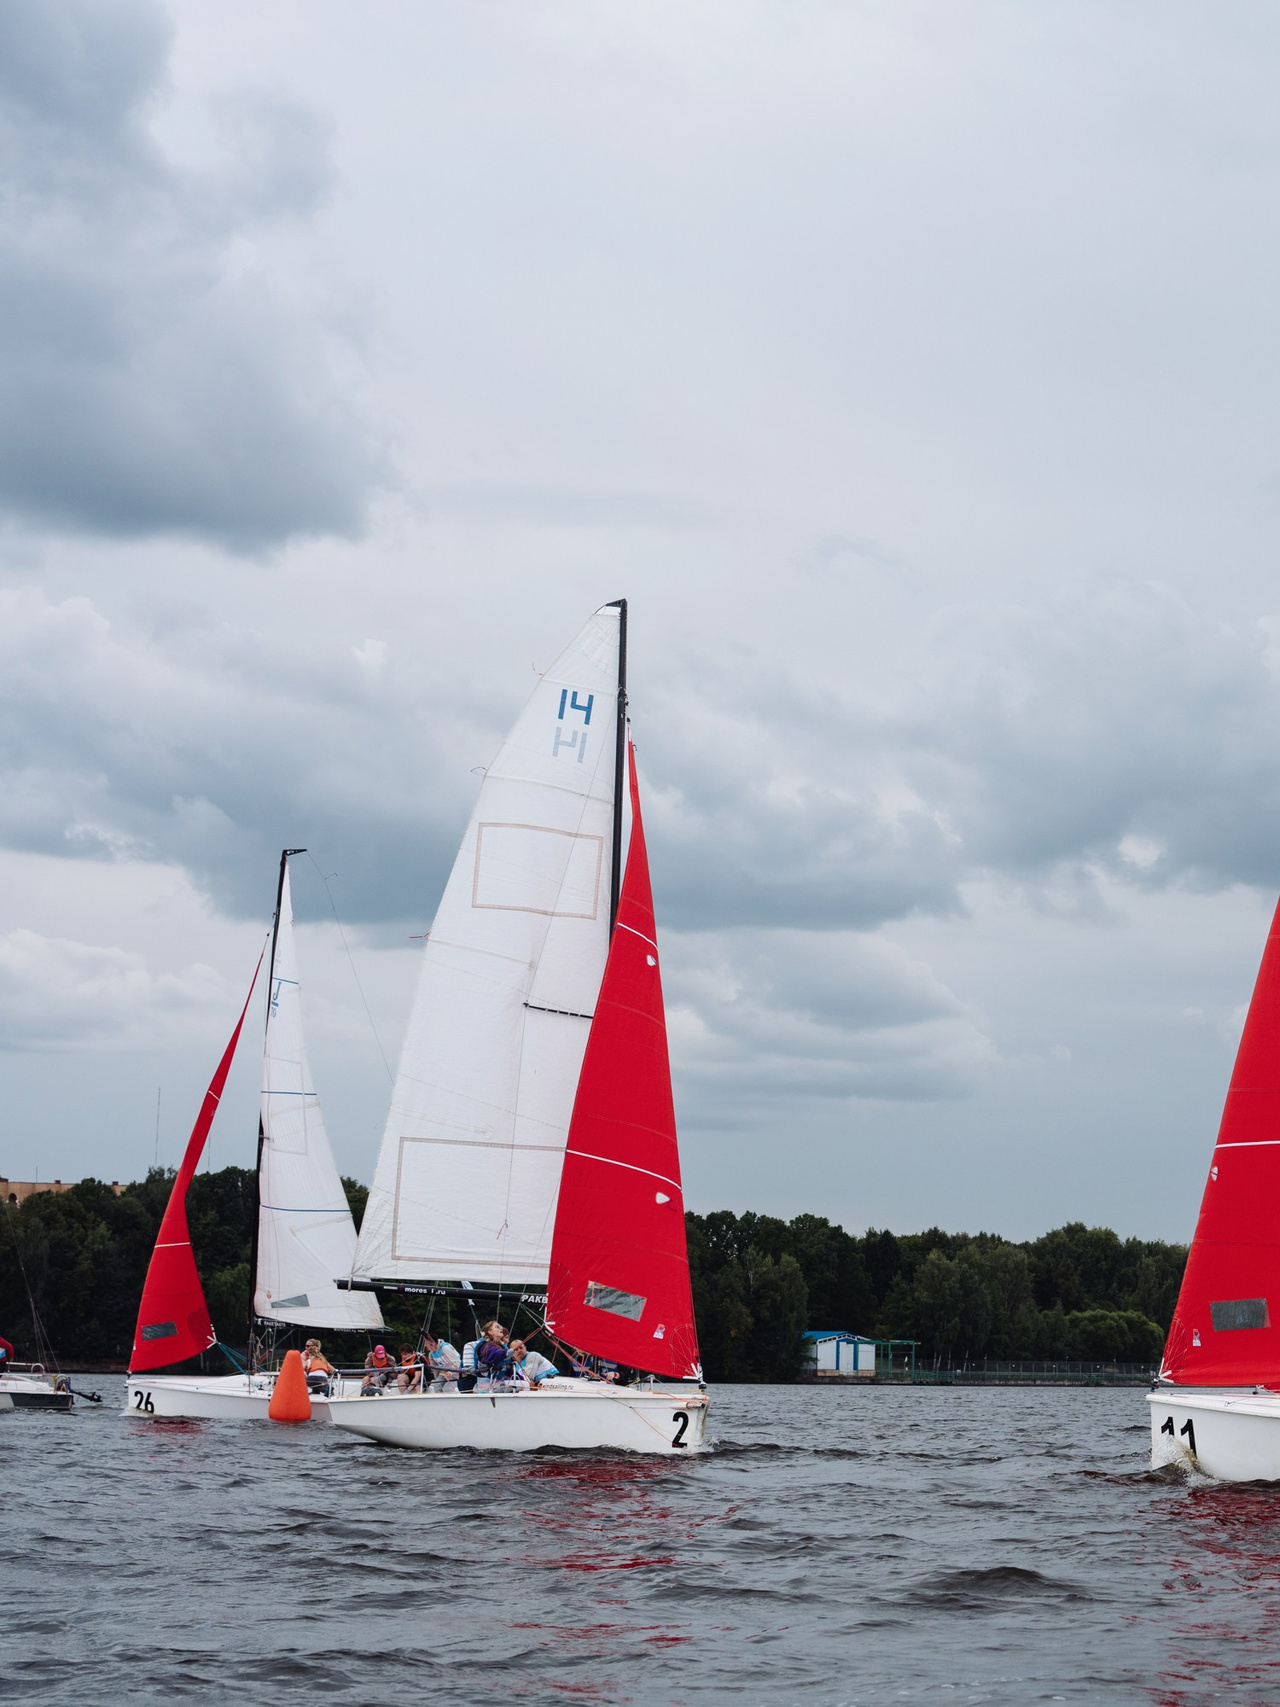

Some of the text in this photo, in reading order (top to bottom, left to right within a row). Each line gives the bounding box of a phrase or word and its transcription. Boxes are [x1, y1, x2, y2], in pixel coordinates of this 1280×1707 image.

[558, 689, 594, 725] 14
[134, 1390, 154, 1414] 26
[672, 1412, 689, 1448] 2
[1161, 1416, 1198, 1459] 11
